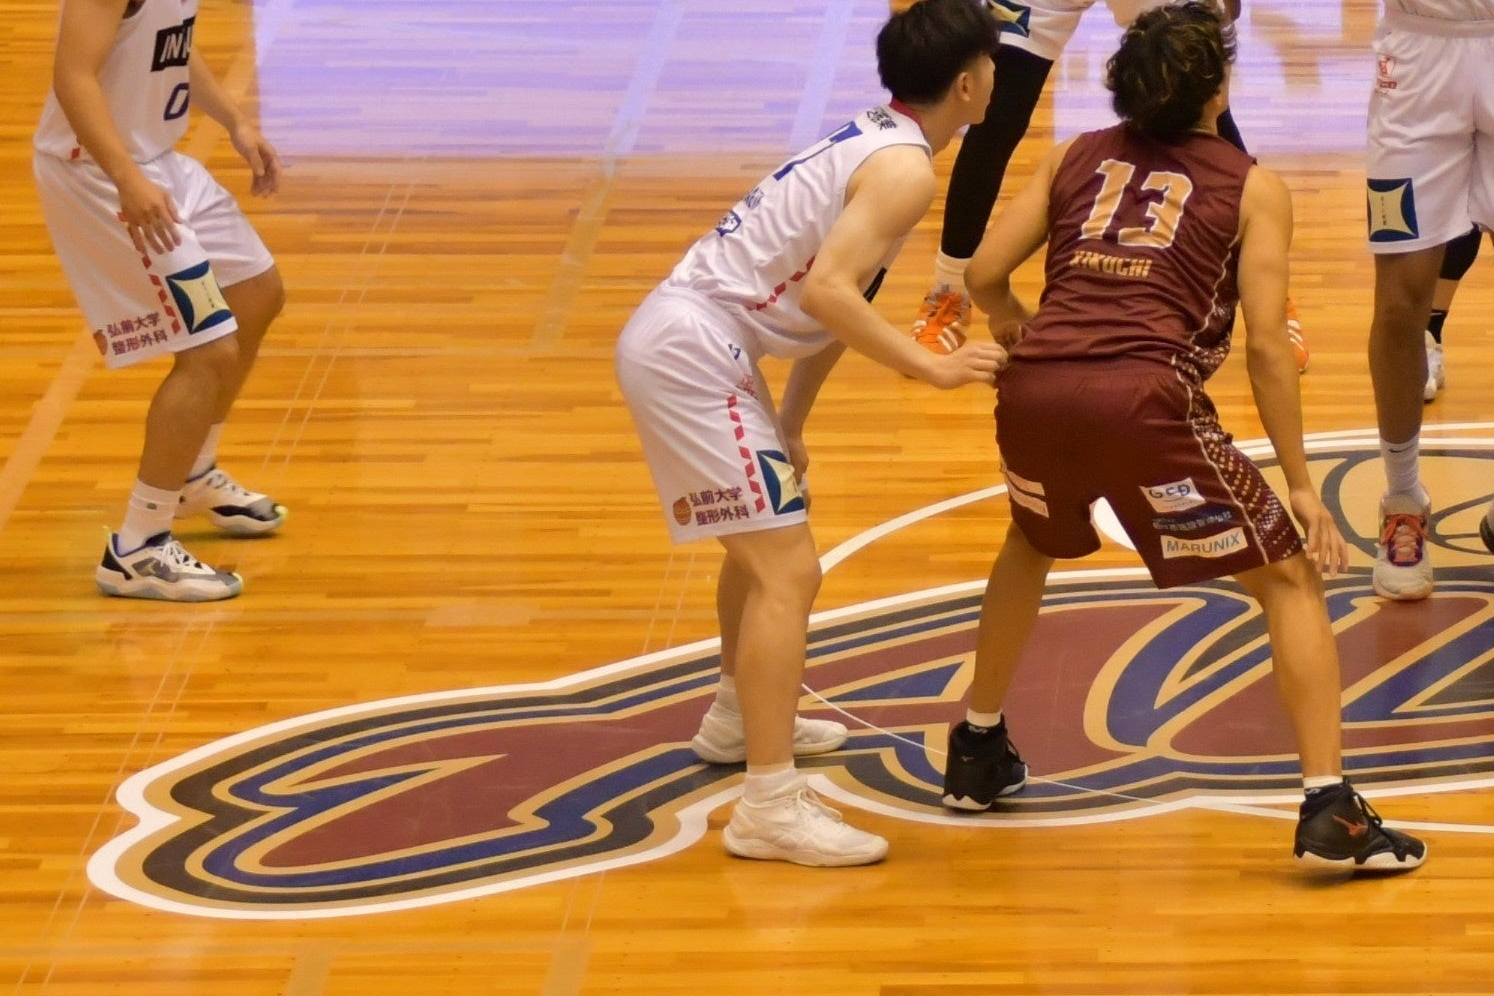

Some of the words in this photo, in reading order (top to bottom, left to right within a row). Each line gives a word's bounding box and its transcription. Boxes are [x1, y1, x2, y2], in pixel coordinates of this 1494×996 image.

[1077, 158, 1194, 250] 13
[1068, 249, 1154, 279] KIKUCHI
[106, 311, 162, 338] 弘前大学
[111, 329, 169, 356] 整形外科
[689, 486, 744, 507] 弘前大学
[694, 504, 751, 526] 整形外科
[1165, 533, 1241, 553] MARUNIX
